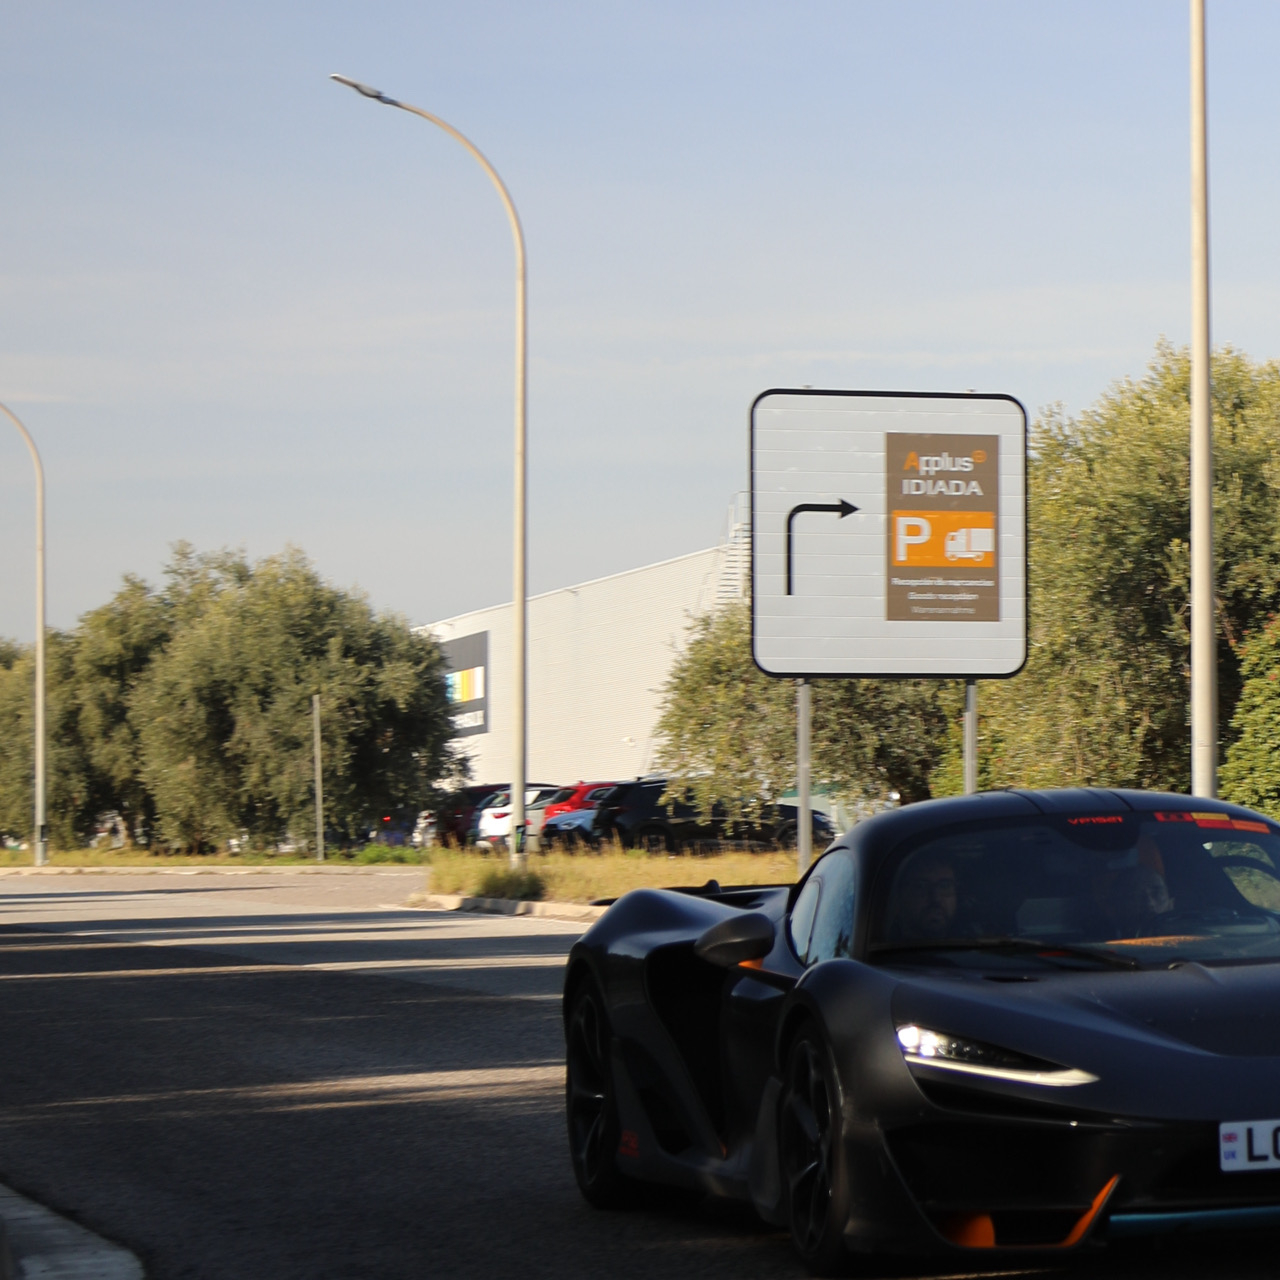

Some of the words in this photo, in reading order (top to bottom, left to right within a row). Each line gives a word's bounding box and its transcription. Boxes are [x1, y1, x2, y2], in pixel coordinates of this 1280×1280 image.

[904, 451, 974, 475] Applus
[902, 479, 984, 496] IDIADA
[896, 516, 931, 561] P
[1223, 1150, 1237, 1161] UK
